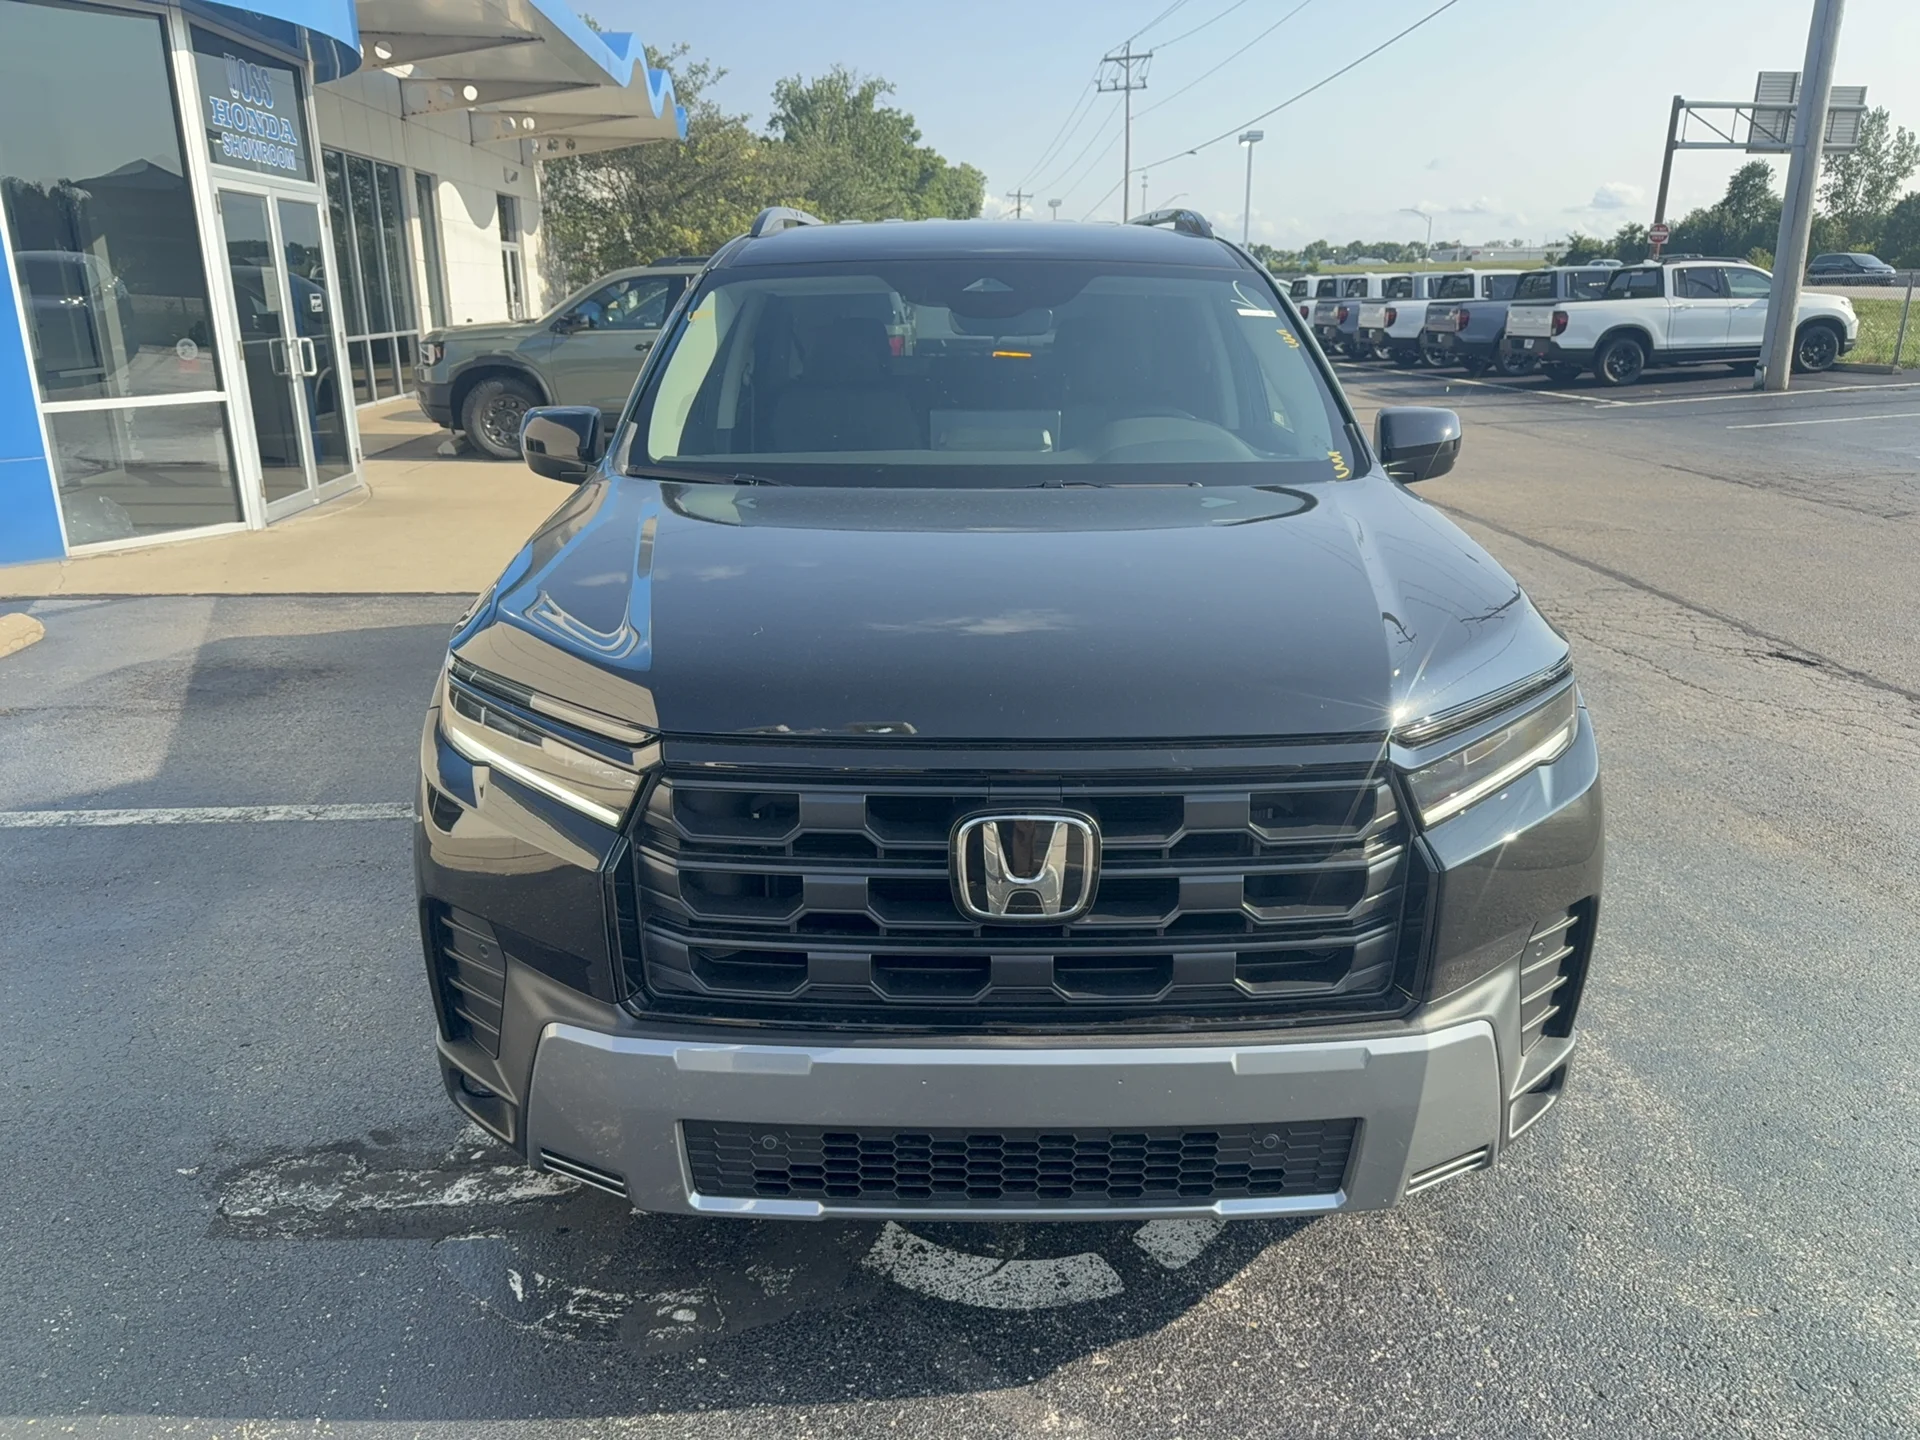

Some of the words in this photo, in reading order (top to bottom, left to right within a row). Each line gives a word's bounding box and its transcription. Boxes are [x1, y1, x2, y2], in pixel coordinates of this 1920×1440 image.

[223, 52, 274, 109] VOSS
[209, 96, 298, 146] HONDA
[221, 131, 297, 171] SHOWROOM
